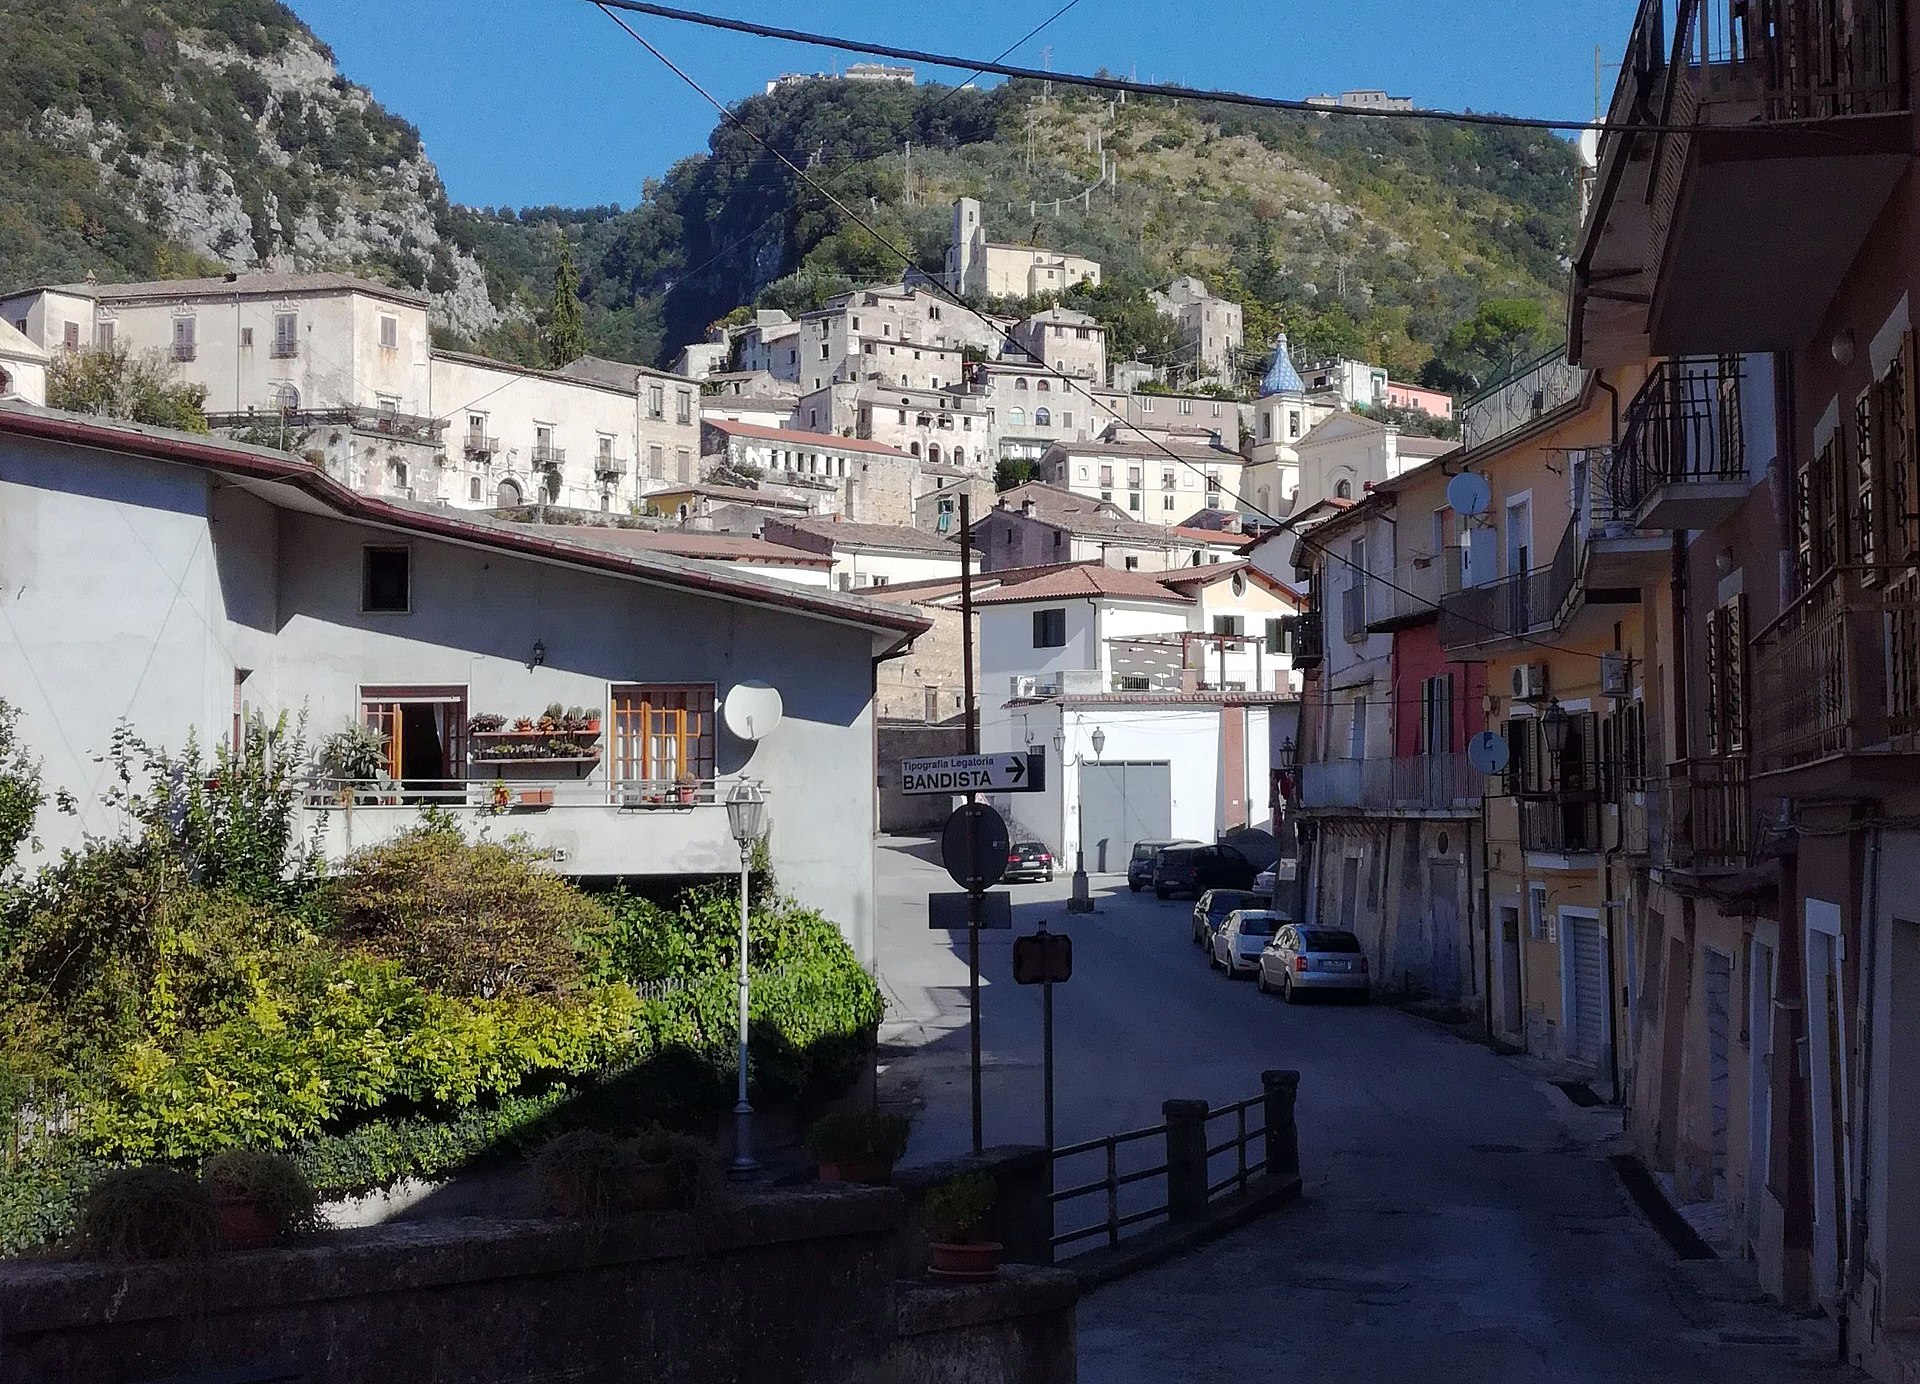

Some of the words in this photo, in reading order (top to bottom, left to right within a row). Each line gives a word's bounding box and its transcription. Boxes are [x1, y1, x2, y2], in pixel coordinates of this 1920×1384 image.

[903, 760, 949, 771] Tipografia
[951, 757, 994, 769] Legatoria
[903, 770, 992, 790] BANDISTA
